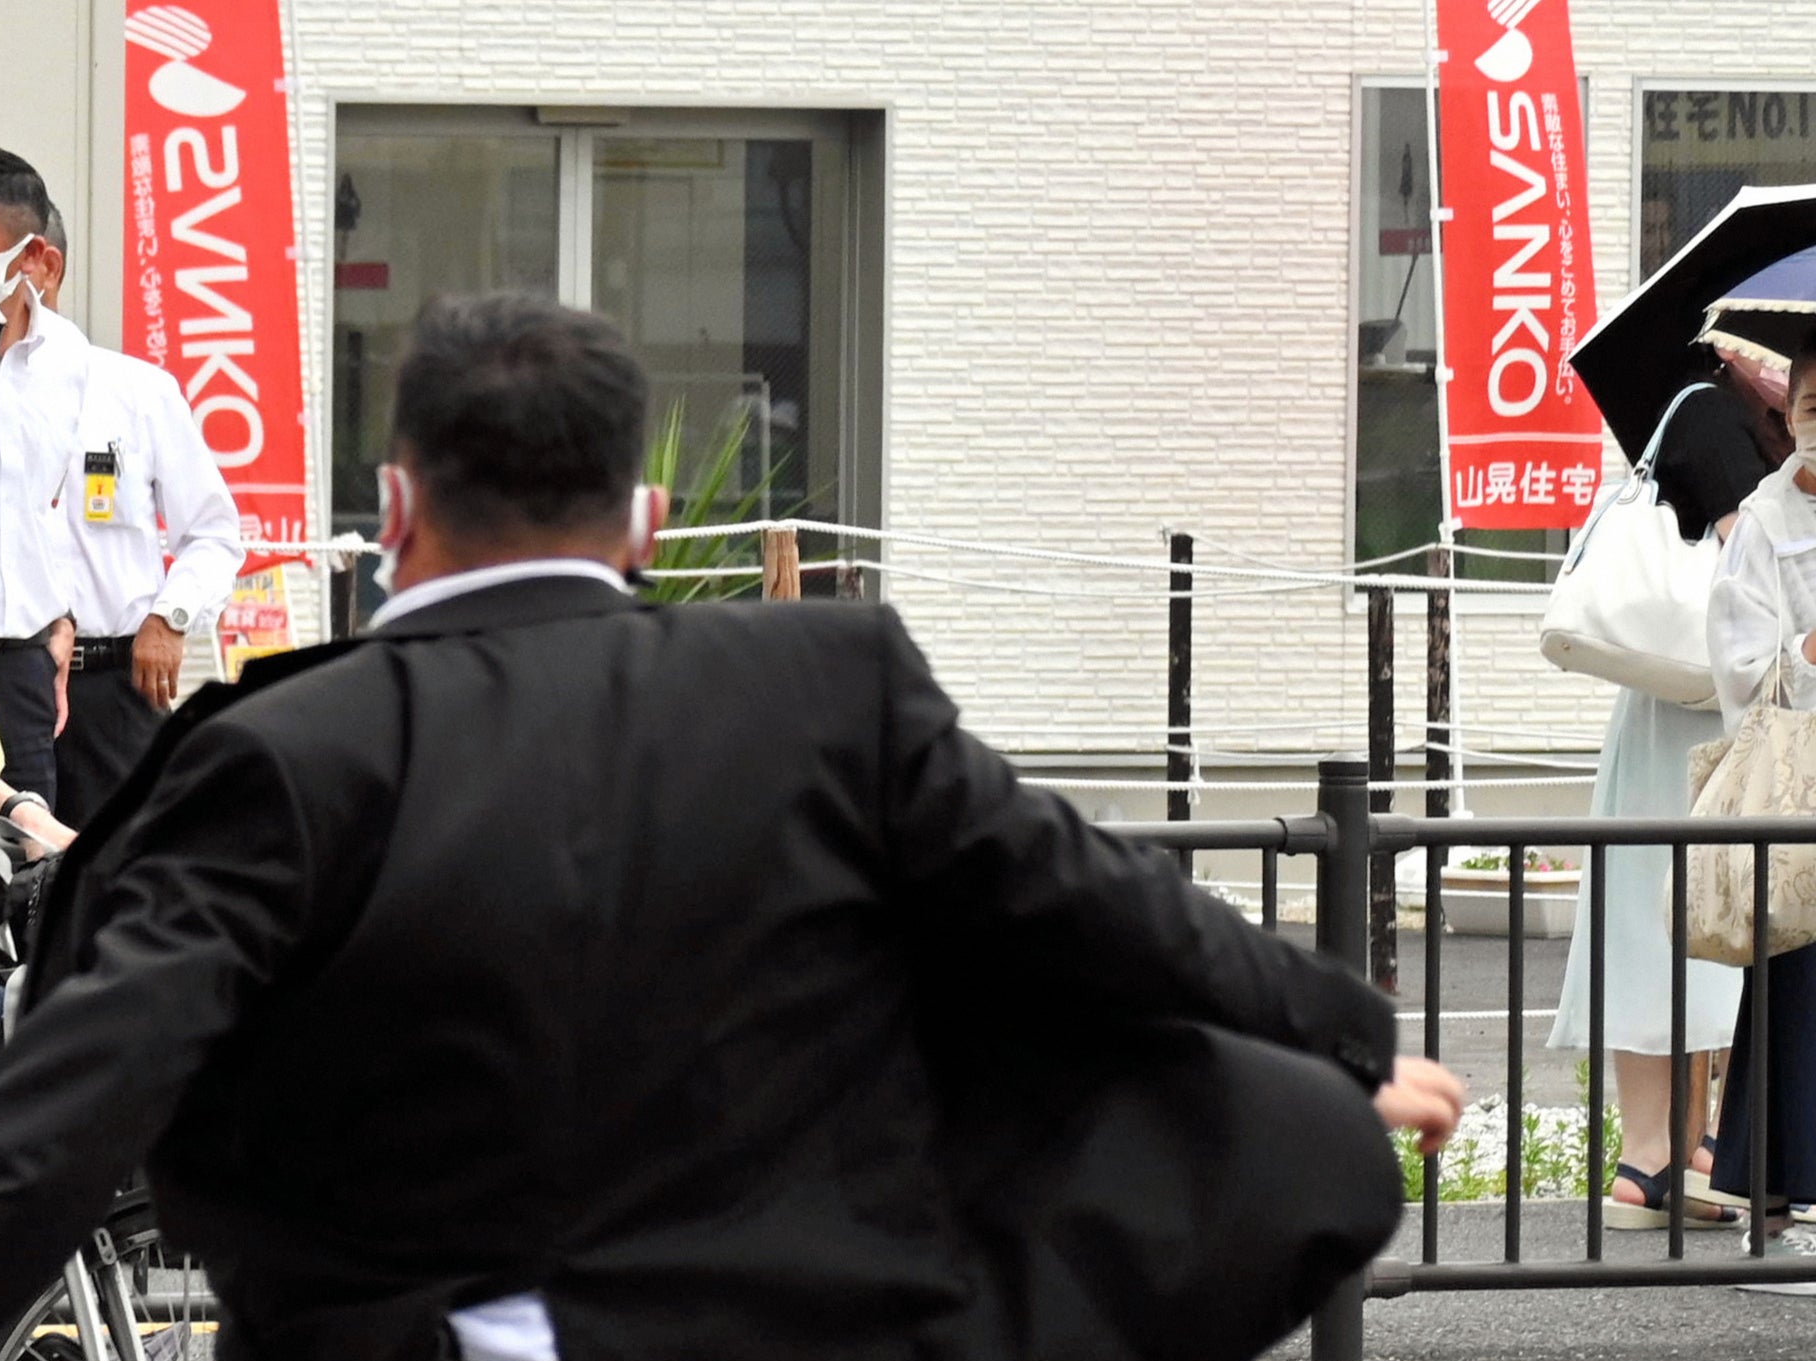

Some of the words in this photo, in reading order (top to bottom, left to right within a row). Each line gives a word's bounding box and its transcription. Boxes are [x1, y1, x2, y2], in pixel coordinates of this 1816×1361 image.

[1487, 90, 1551, 417] SANKO
[1455, 460, 1597, 508] 山晃住宅
